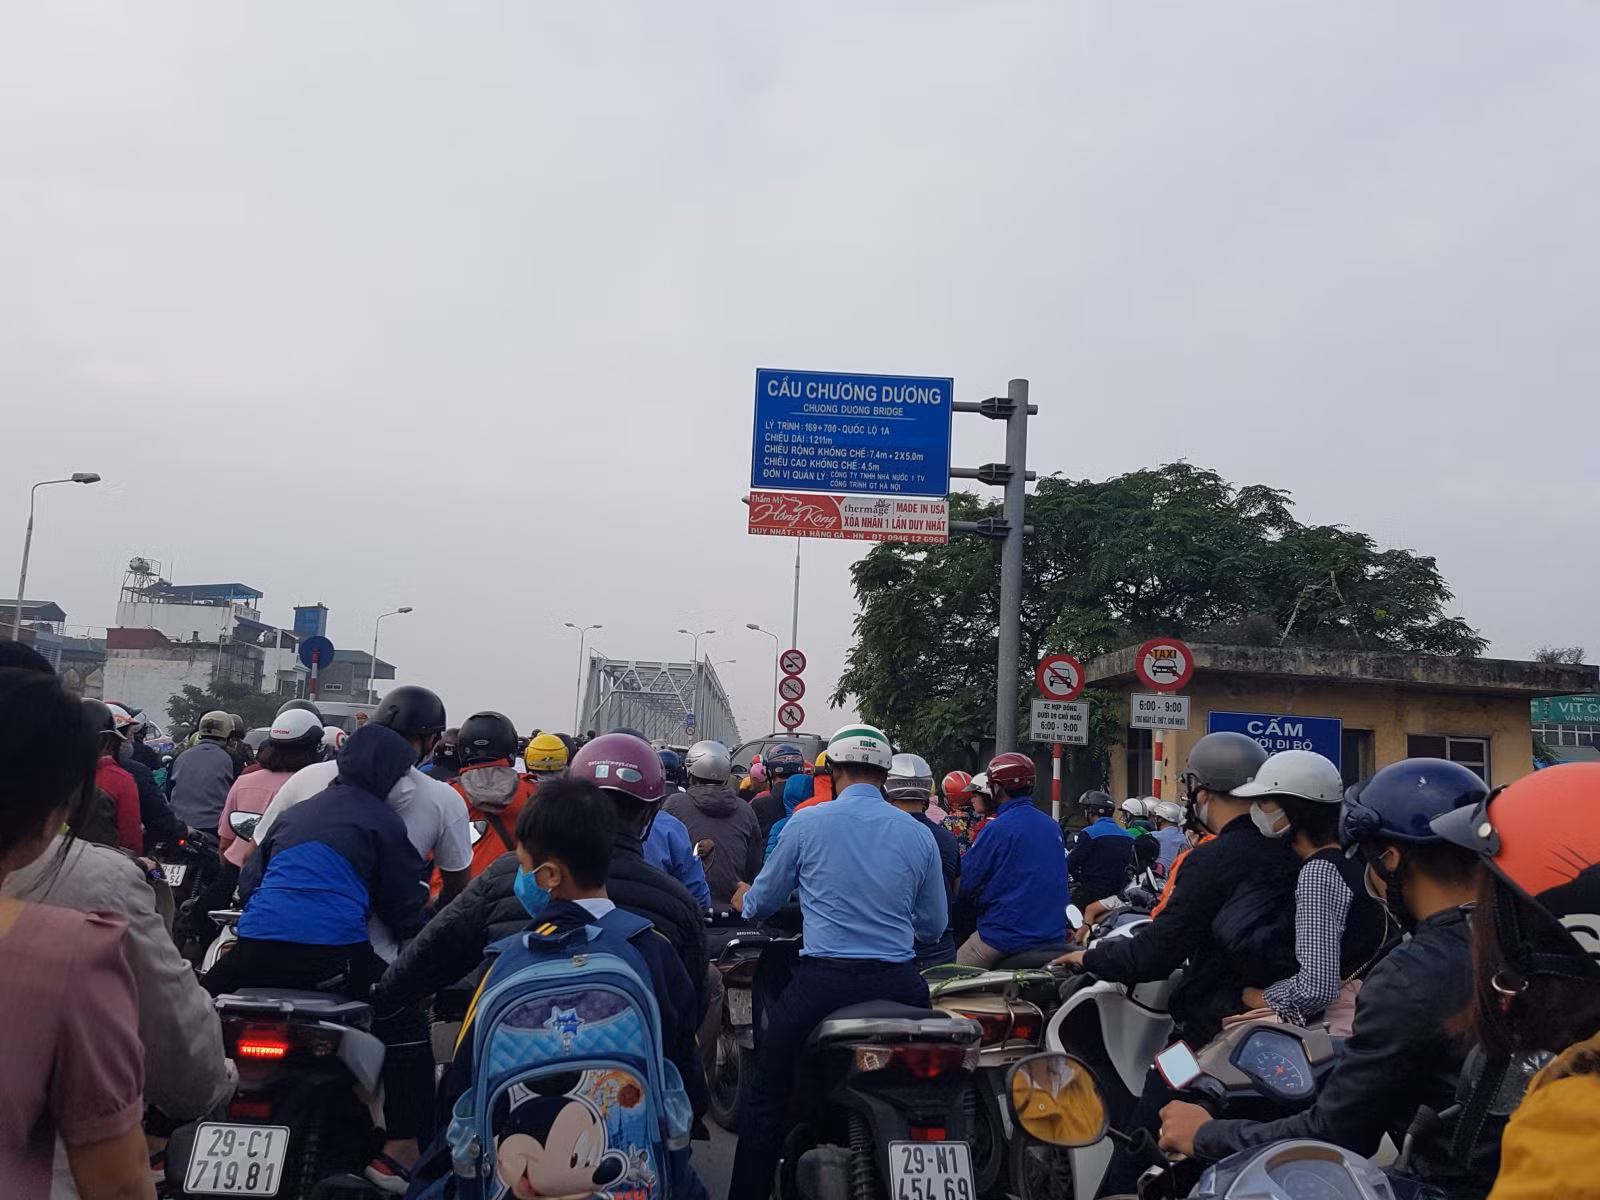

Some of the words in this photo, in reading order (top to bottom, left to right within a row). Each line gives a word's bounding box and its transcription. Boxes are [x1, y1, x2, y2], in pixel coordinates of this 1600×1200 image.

[767, 376, 802, 398] CẦU
[806, 381, 877, 402] CHƯƠNG
[881, 384, 941, 405] DƯƠNG
[803, 403, 838, 413] CHUONG
[841, 404, 870, 415] DUONG
[873, 406, 904, 416] BRIDGE
[867, 425, 877, 436] LỘ
[881, 426, 890, 435] 1A
[791, 444, 815, 456] RỘNG
[791, 458, 807, 467] CAO
[830, 470, 847, 479] CÔNG
[860, 472, 876, 480] TNHH
[850, 480, 866, 488] TRÌNH
[880, 481, 888, 489] HÀ
[890, 481, 901, 491] NỘI
[844, 503, 889, 516] thermage
[896, 503, 918, 513] MADE
[920, 504, 928, 513] IN
[930, 504, 945, 514] USA
[844, 514, 859, 527] XÓA
[885, 518, 889, 528] 1
[908, 519, 924, 530] DUY
[910, 535, 921, 543] 12
[1153, 649, 1177, 659] TAXI
[1139, 700, 1156, 711] 6:00
[1165, 701, 1182, 713] 9:00
[1587, 703, 1600, 714] C
[1040, 720, 1056, 730] 6:00
[1063, 722, 1078, 732] 9:00
[1247, 716, 1303, 737] CẤM
[860, 739, 877, 748] mic
[1276, 740, 1289, 749] ĐI
[207, 1128, 273, 1159] 29-C1
[901, 1146, 958, 1174] 29-N1
[191, 1159, 275, 1191] 719.81
